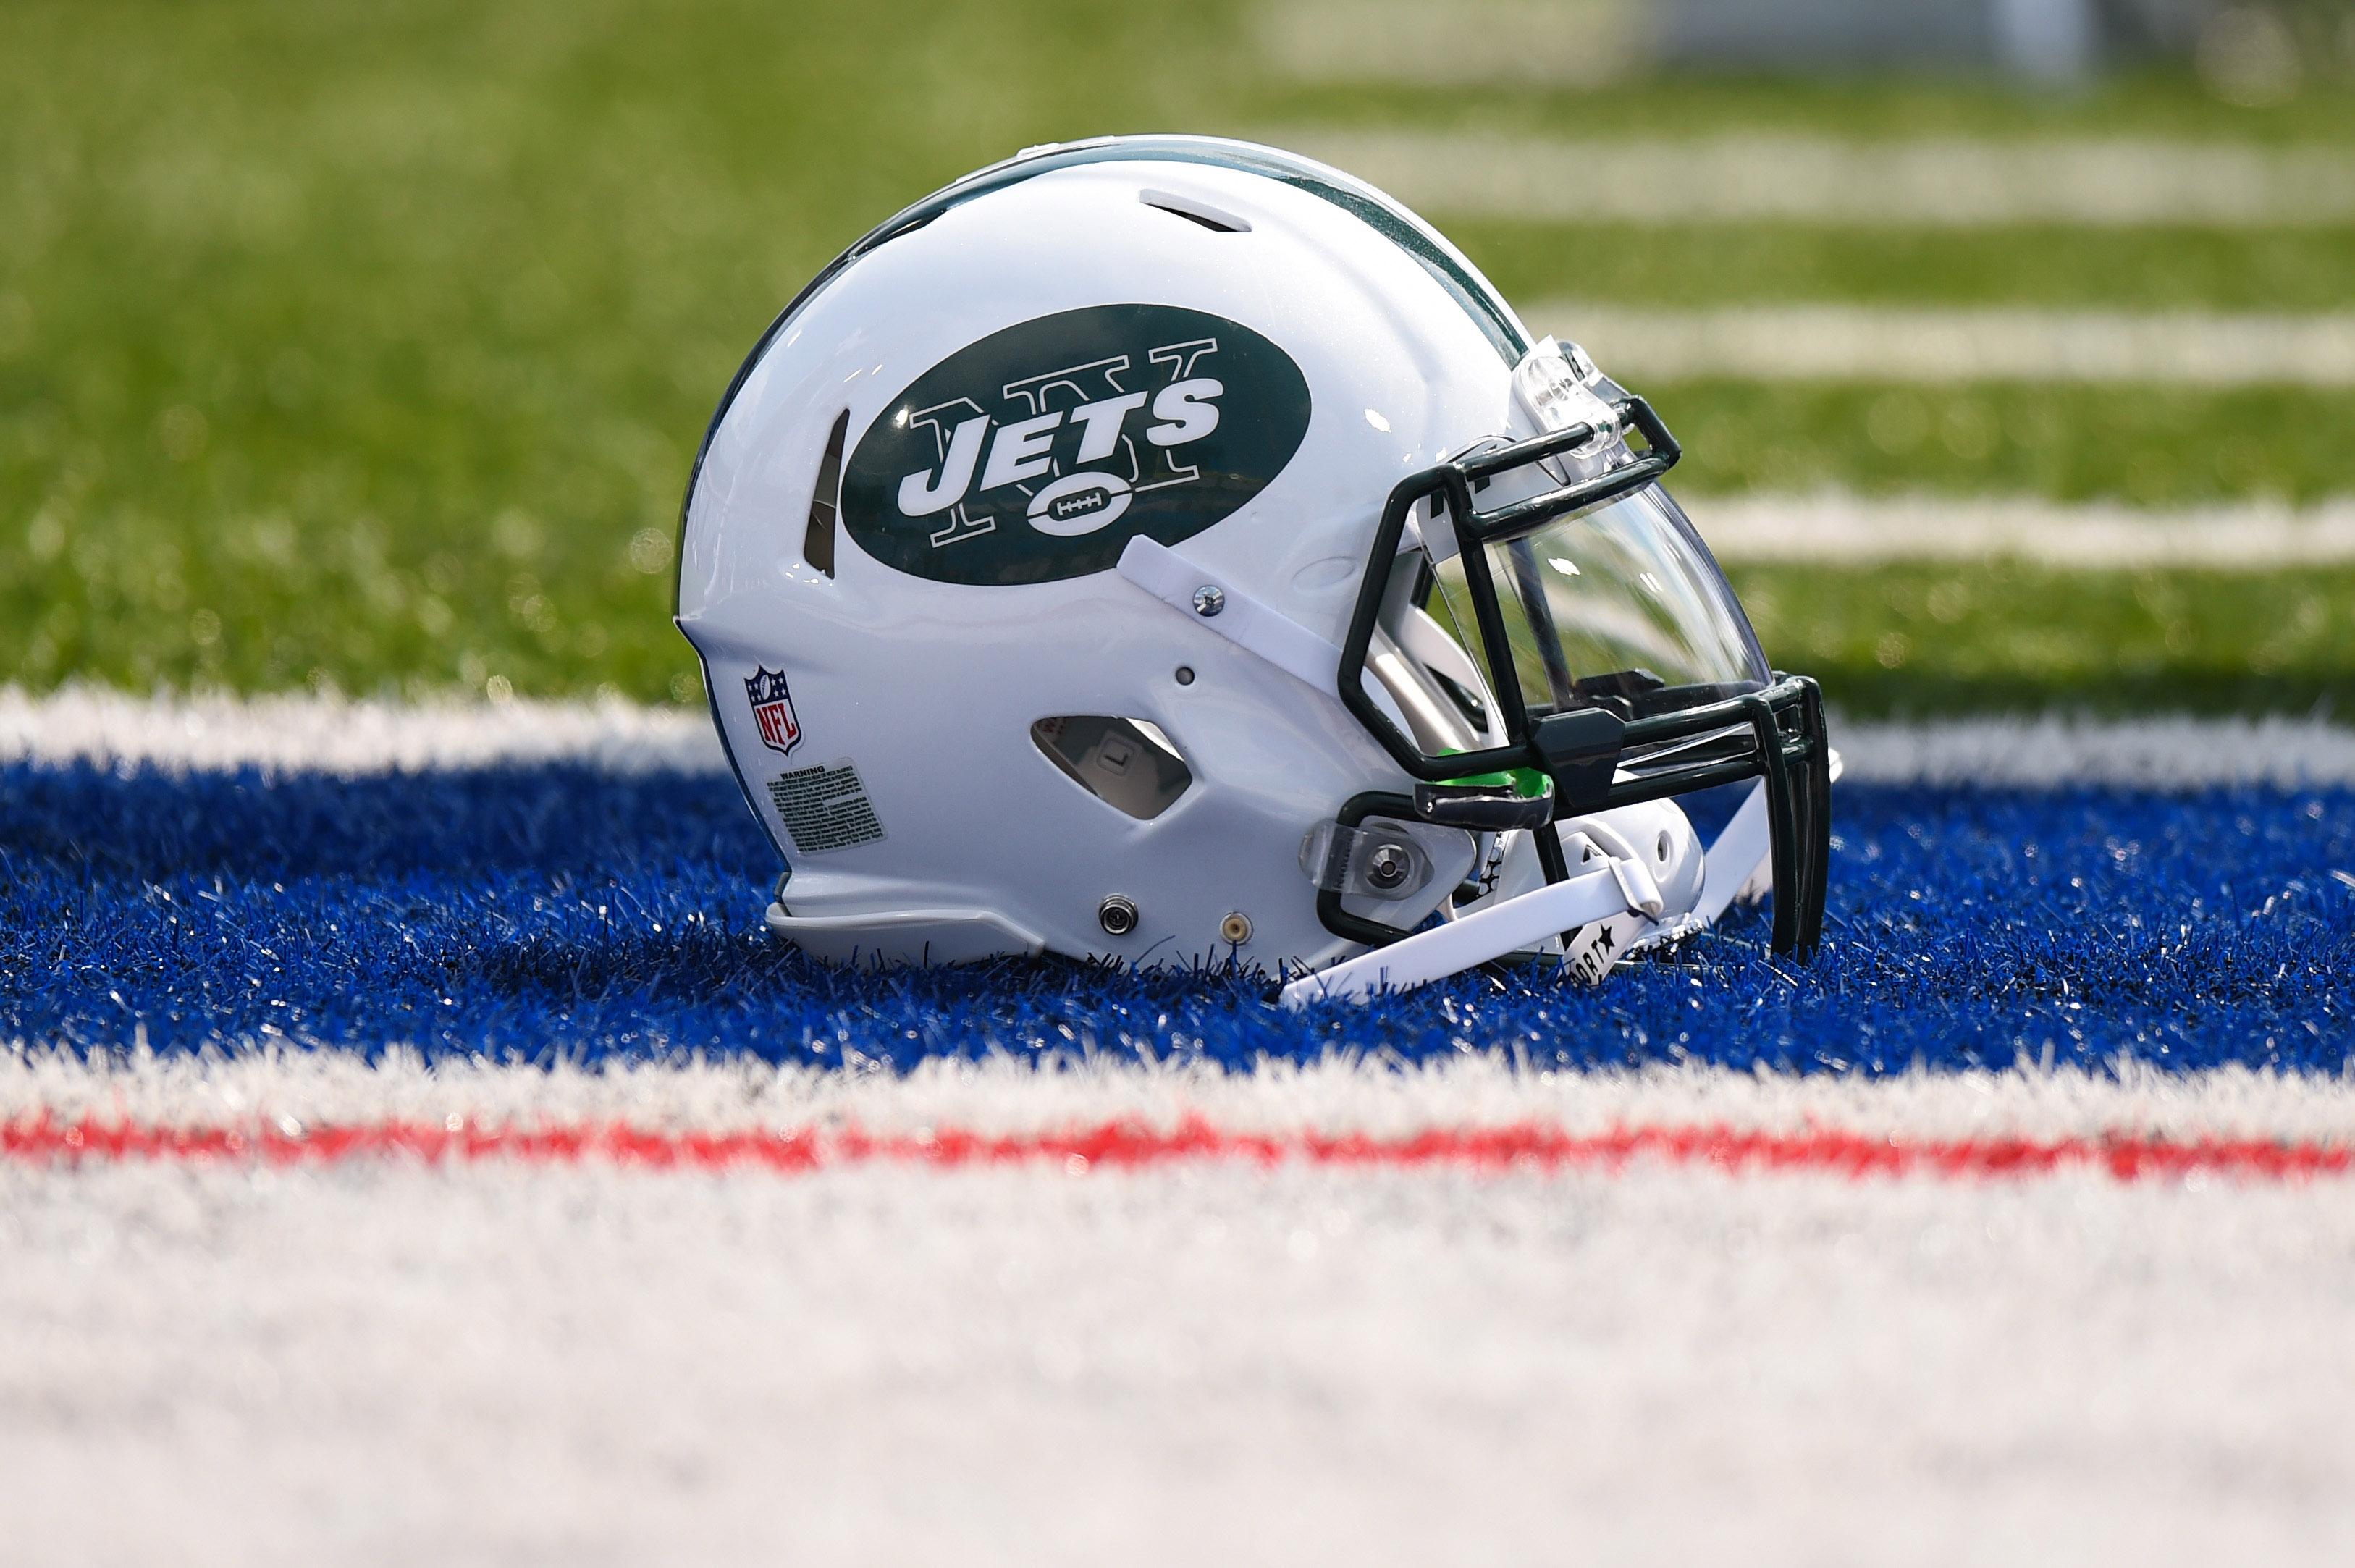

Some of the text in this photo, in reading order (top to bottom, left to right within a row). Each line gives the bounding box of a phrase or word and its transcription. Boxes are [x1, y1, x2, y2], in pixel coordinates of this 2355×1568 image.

[897, 378, 1223, 517] JETS
[756, 703, 797, 745] NFL
[780, 765, 826, 780] WARNING
